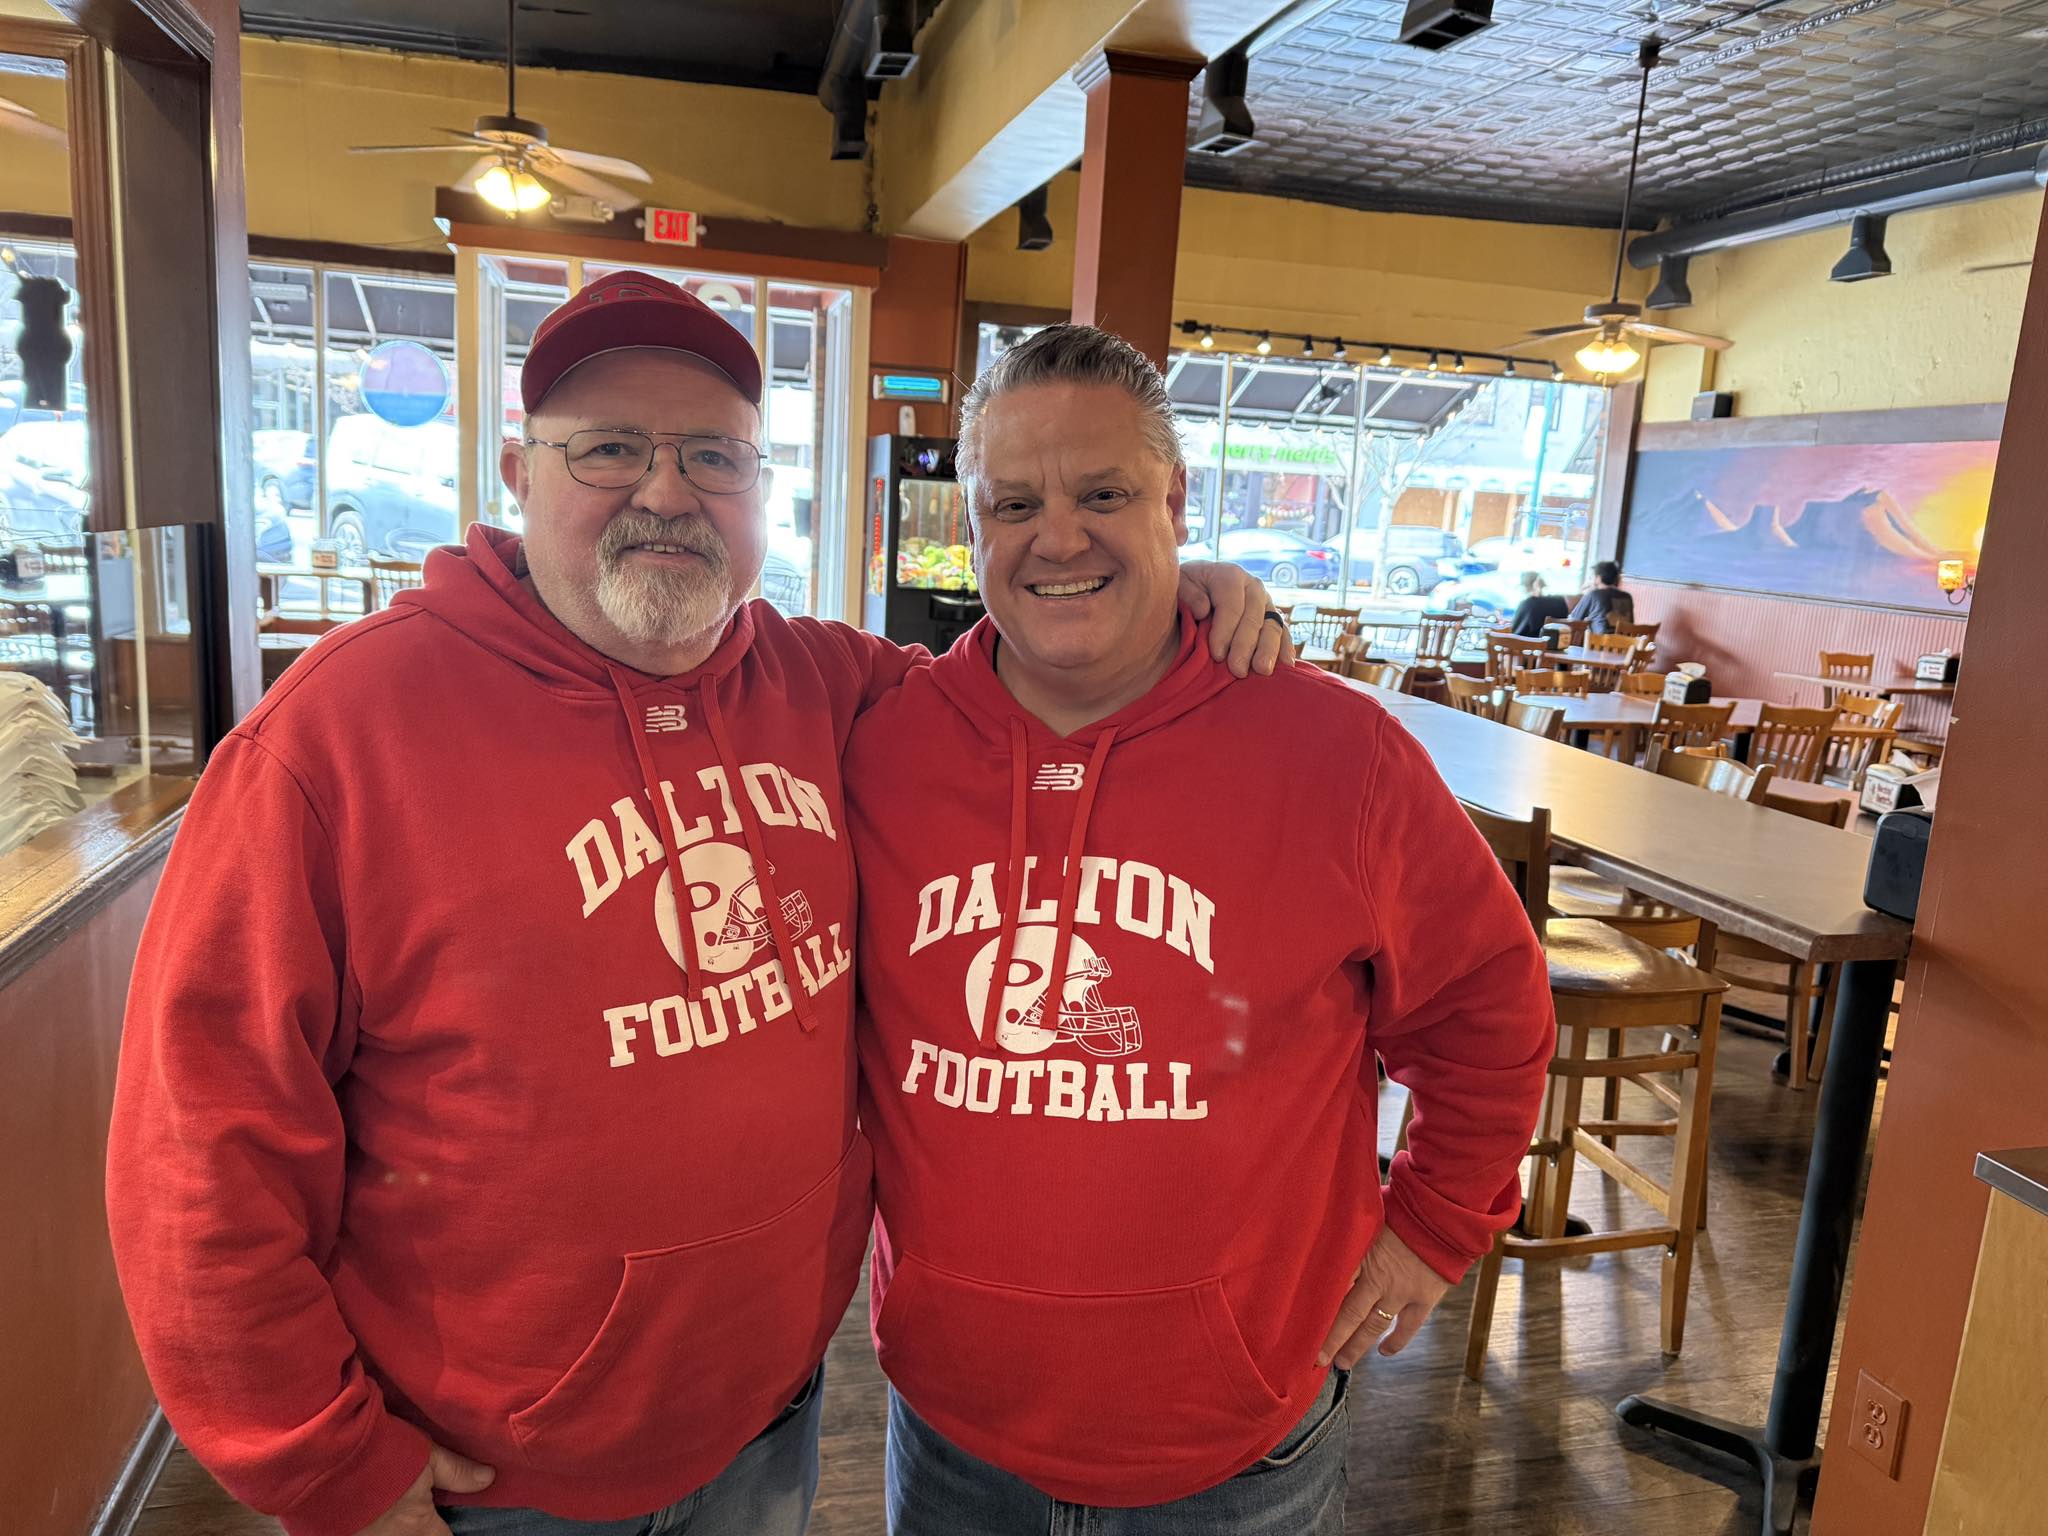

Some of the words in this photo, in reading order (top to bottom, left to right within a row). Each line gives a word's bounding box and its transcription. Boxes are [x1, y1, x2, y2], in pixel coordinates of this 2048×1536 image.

[655, 209, 689, 242] EXIT
[565, 763, 836, 919] DALTON
[909, 855, 1216, 975] DALTON
[603, 922, 851, 1068] FOOTBALL
[902, 1039, 1208, 1122] FOOTBALL
